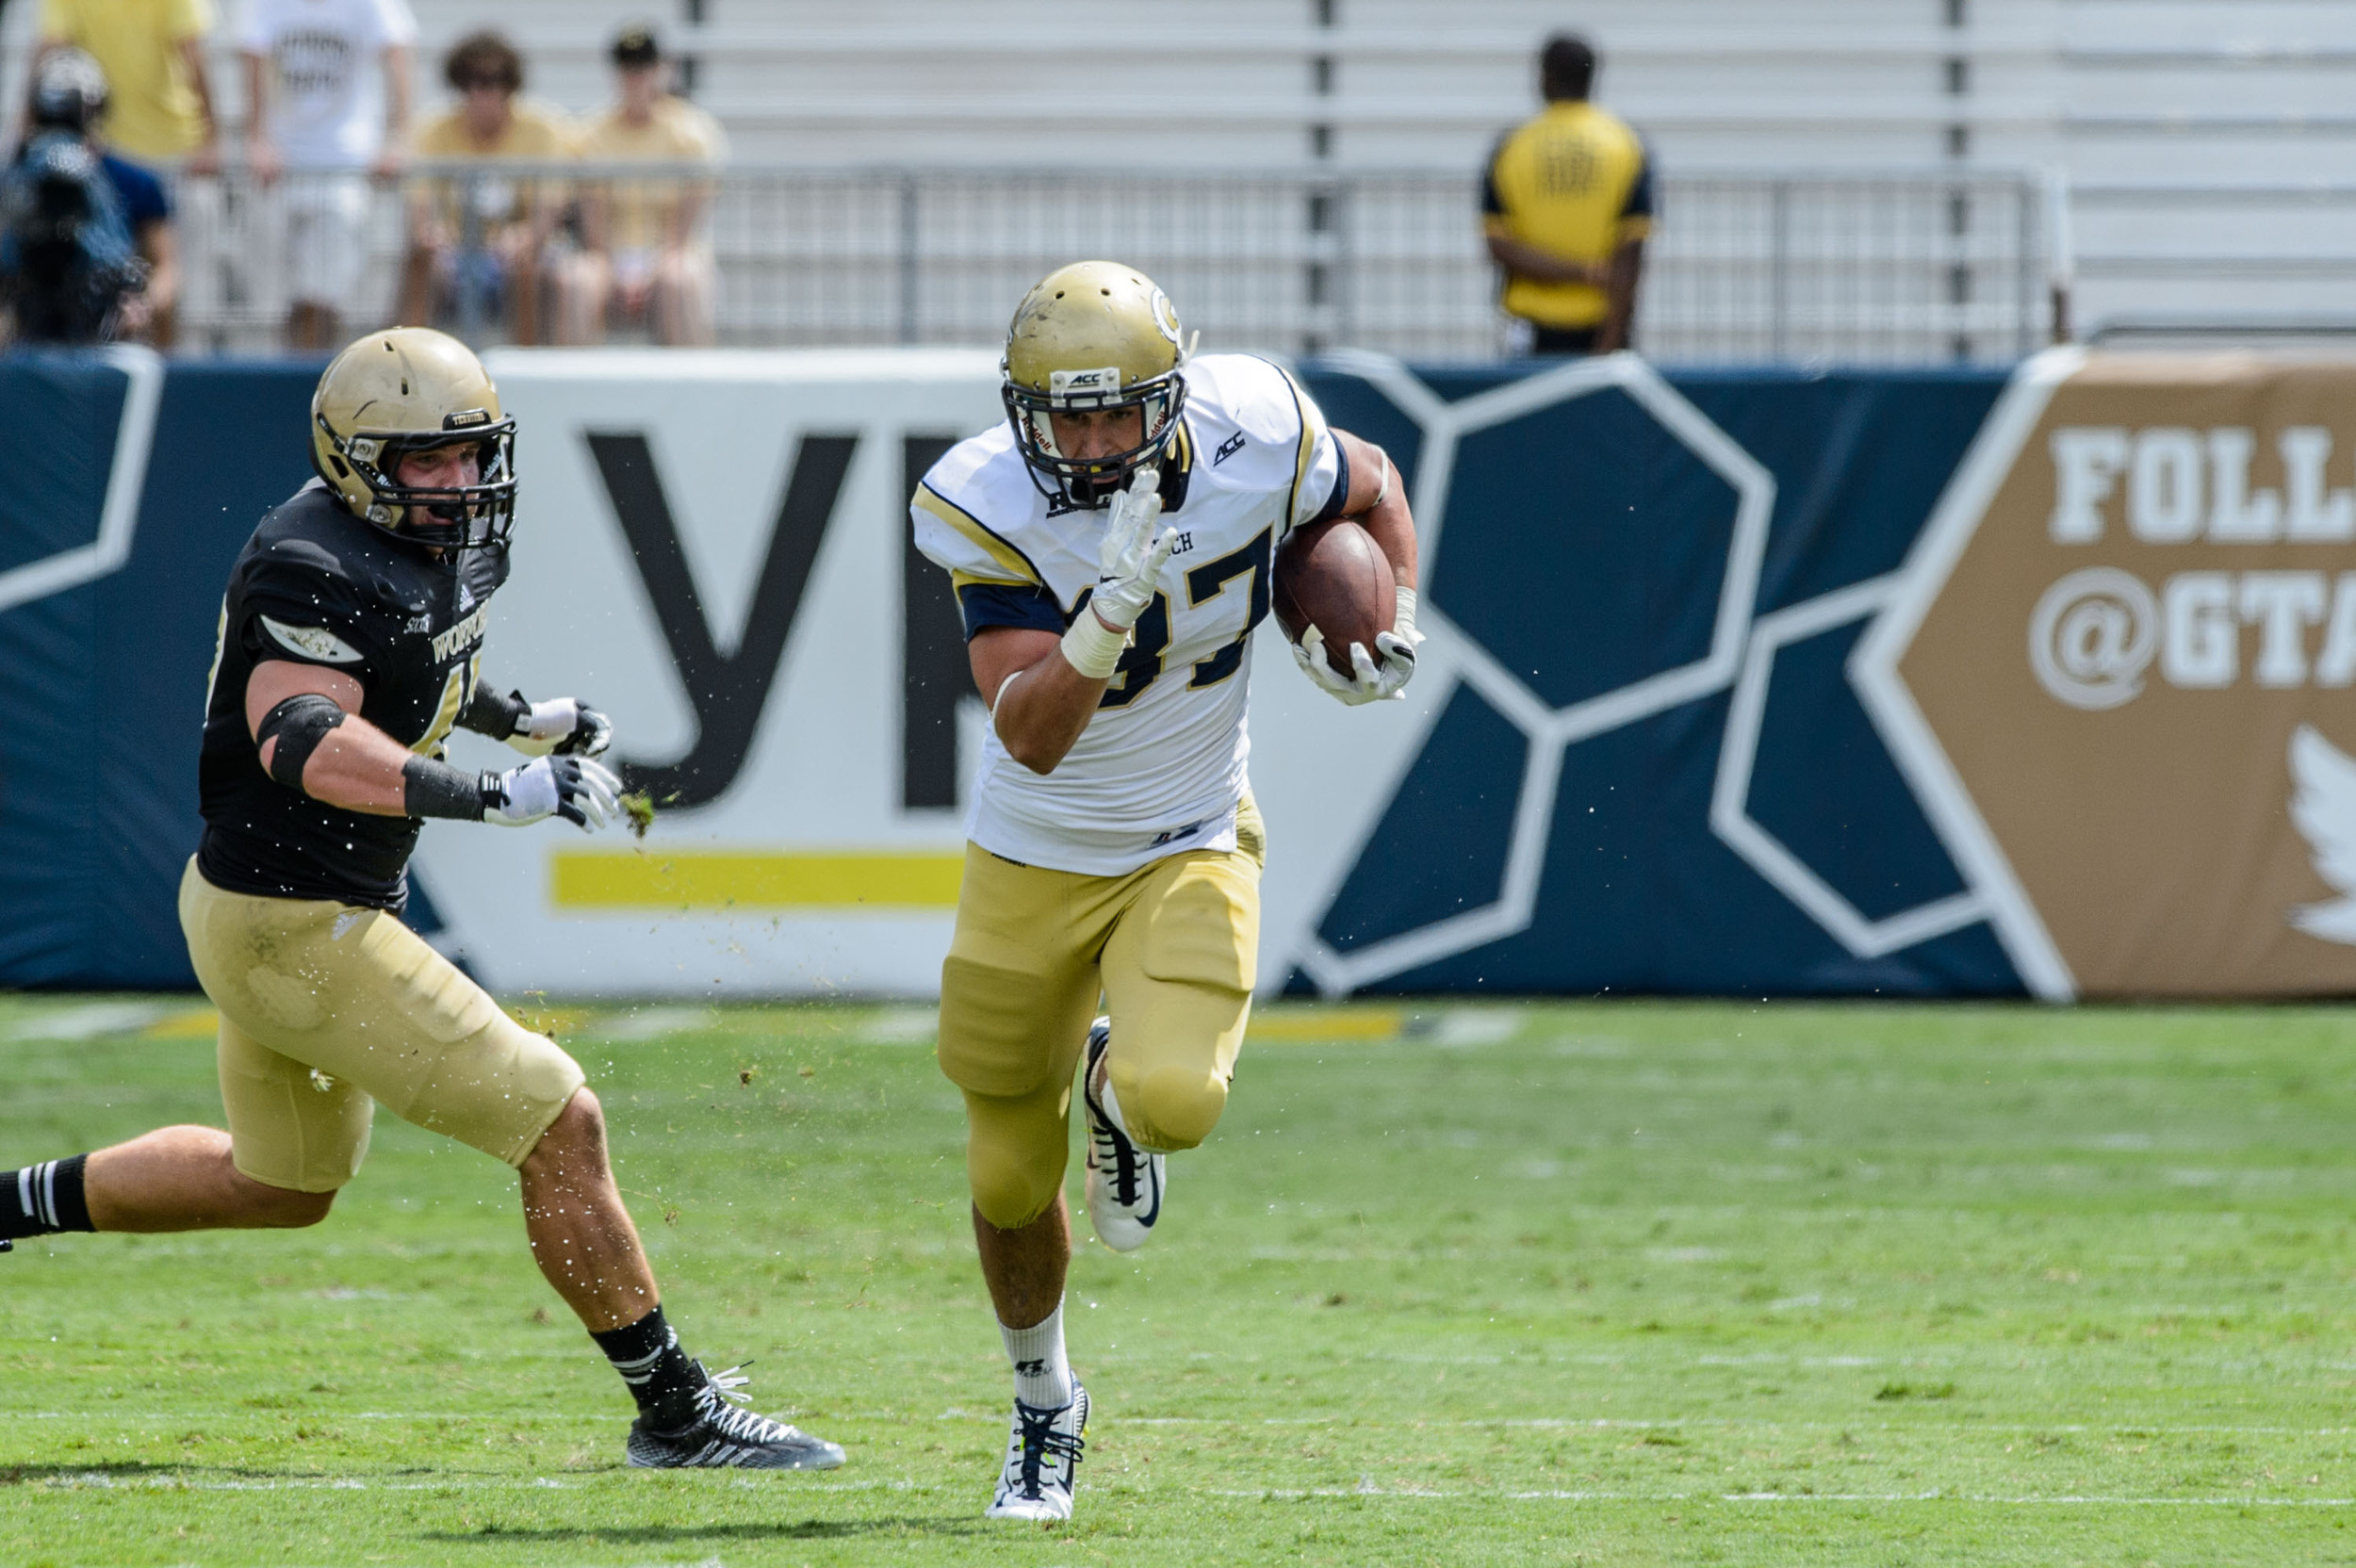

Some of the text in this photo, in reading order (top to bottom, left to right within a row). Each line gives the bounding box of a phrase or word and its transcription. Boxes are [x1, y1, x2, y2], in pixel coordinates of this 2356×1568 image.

[1070, 373, 1101, 385] ACC
[1214, 430, 1246, 466] ACC
[2048, 427, 2356, 543] FOLL
